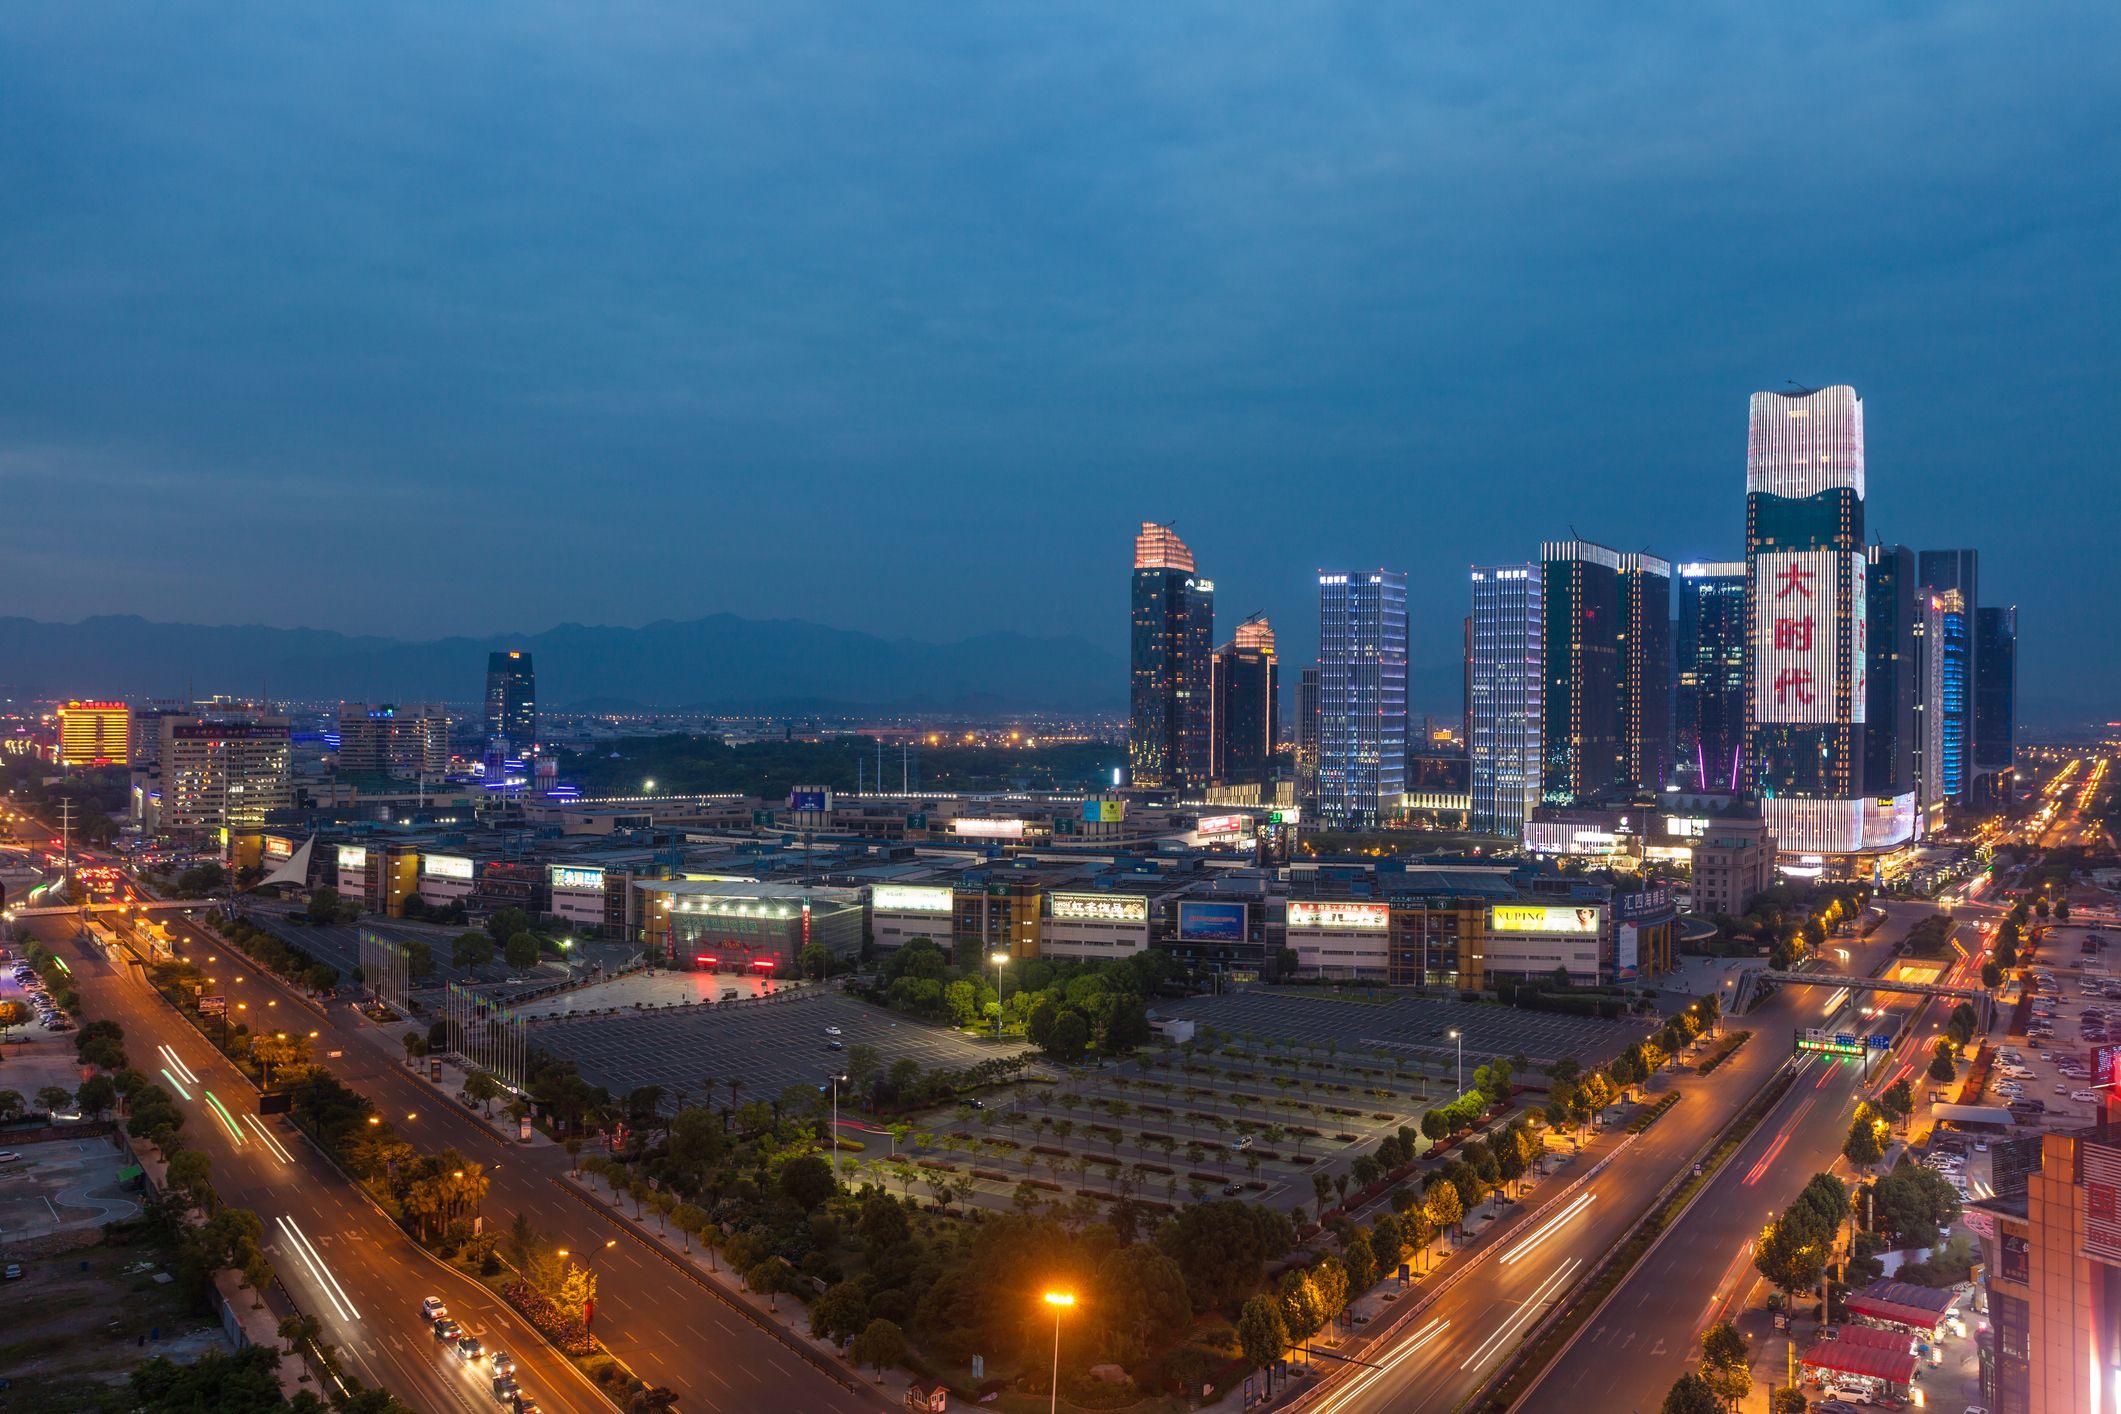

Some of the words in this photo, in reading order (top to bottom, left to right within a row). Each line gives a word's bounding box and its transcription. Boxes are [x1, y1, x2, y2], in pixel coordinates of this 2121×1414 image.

[1775, 562, 1815, 706] 大时代
[1497, 912, 1544, 921] XUPING
